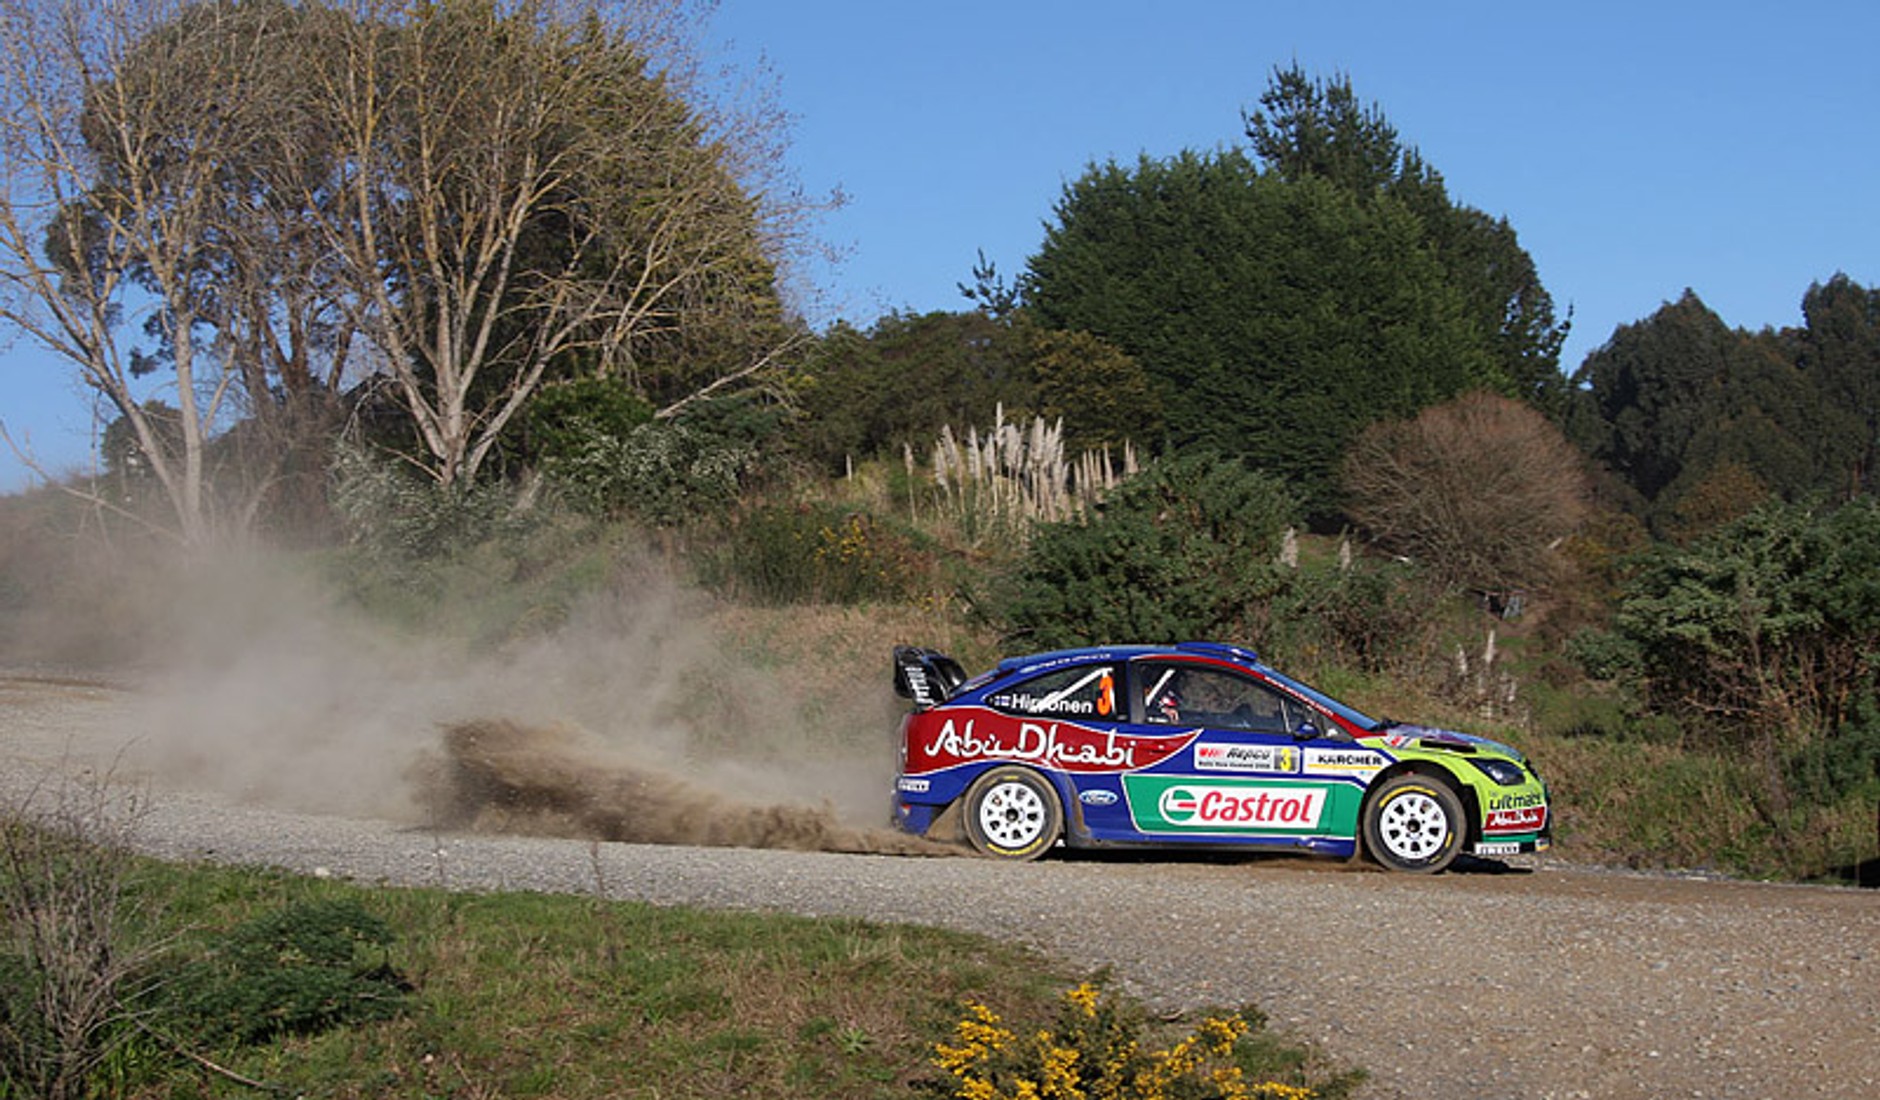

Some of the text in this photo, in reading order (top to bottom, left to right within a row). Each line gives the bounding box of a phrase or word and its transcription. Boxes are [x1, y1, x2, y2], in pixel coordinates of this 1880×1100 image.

[1011, 693, 1093, 714] Hironen
[1097, 675, 1114, 715] 3
[1011, 722, 1136, 767] Dhabi
[1280, 747, 1292, 771] 3
[1199, 790, 1313, 823] Castrol
